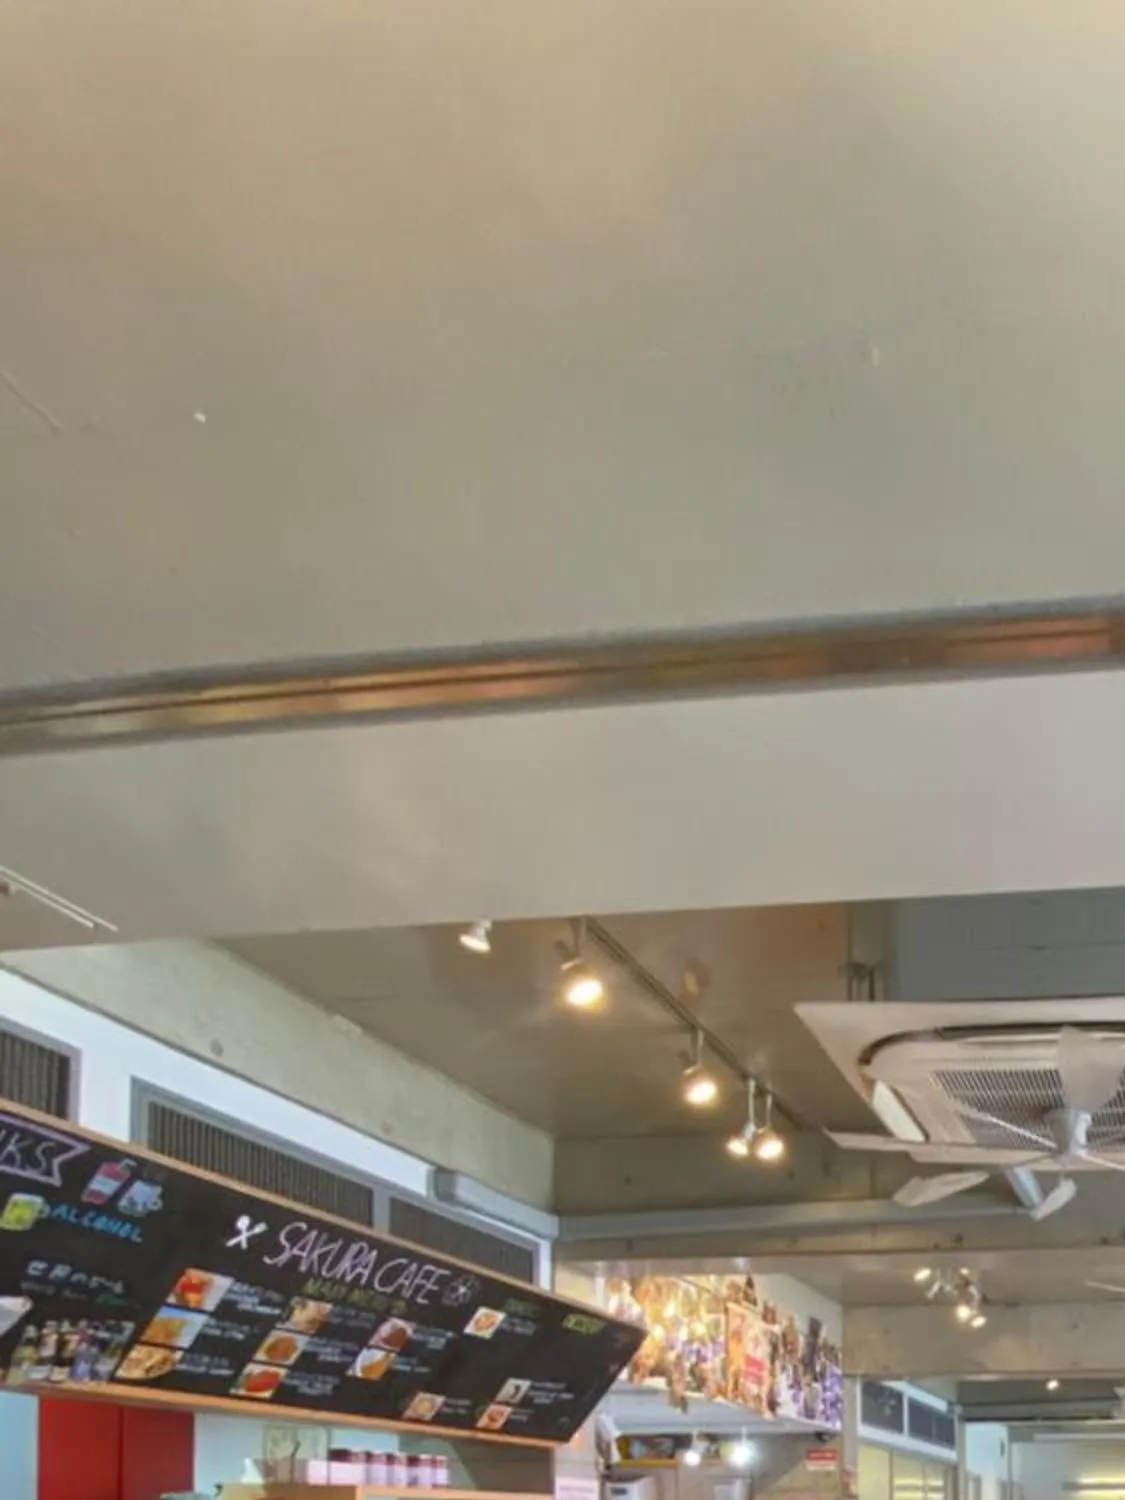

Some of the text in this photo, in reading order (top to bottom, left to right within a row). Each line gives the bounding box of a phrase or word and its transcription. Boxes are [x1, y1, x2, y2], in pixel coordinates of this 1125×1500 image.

[0, 1129, 56, 1174] KS
[262, 1222, 378, 1286] SAKURA
[374, 1258, 450, 1304] CAFE
